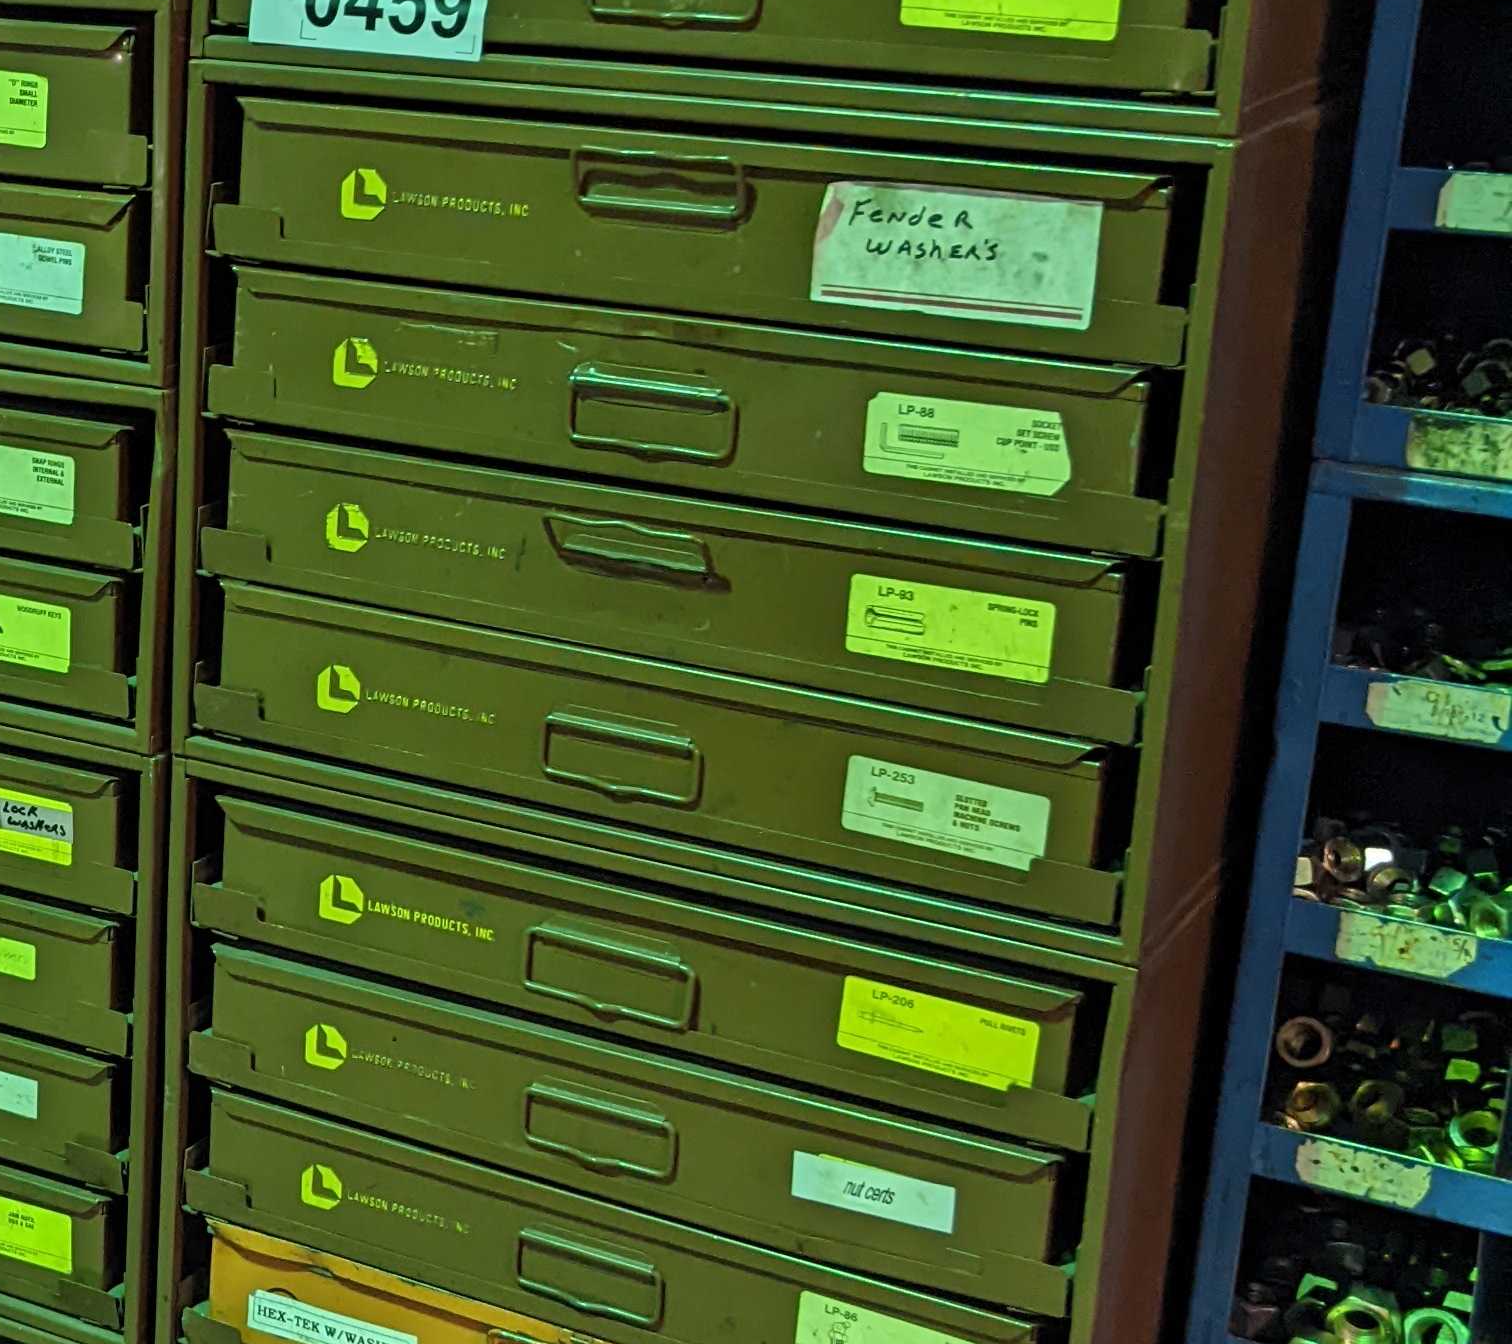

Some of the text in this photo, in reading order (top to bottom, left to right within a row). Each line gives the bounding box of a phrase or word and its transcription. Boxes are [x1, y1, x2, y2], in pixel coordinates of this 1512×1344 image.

[442, 196, 505, 216] PRODUCTS,
[510, 204, 529, 217] INC
[498, 377, 518, 391] INC
[898, 404, 934, 418] LP-88
[487, 546, 506, 560] INC
[871, 767, 916, 785] LP-253
[367, 900, 410, 920] LAWSON
[414, 912, 471, 937] PRODUCTS,
[872, 989, 914, 1009] LP-206
[843, 1181, 896, 1205] nut certs
[257, 1304, 321, 1333] HEX-TEK
